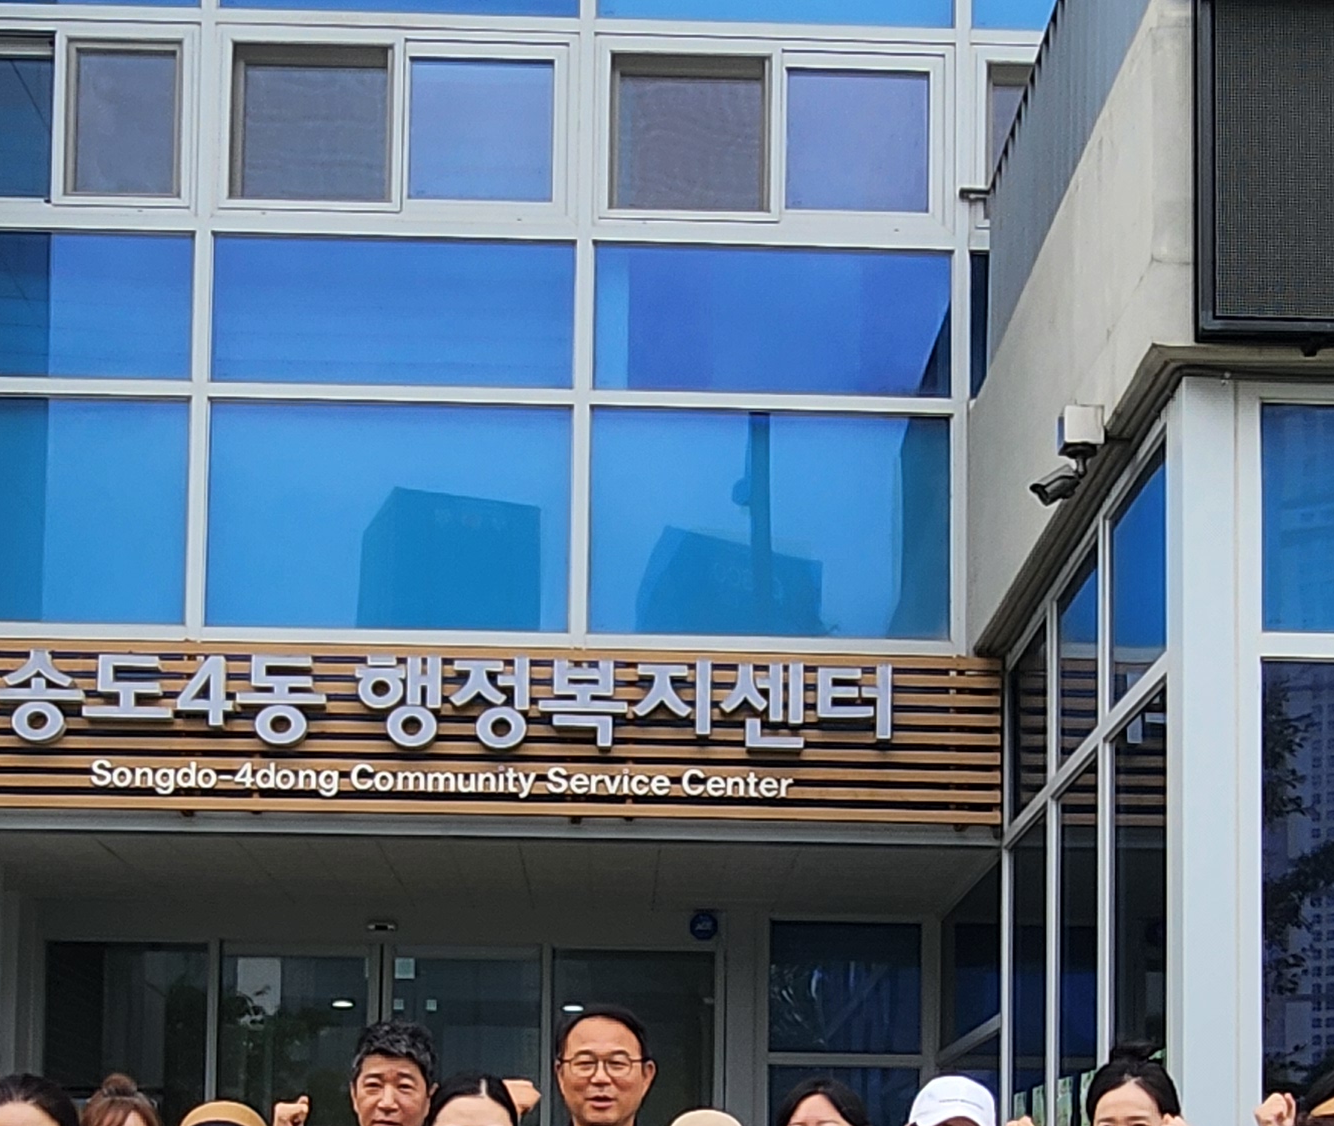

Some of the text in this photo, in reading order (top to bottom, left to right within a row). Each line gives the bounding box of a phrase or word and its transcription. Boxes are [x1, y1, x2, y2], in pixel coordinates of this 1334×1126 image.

[354, 655, 894, 751] 행정복지센터
[90, 759, 795, 798] Songdo-4dong Community Service Center
